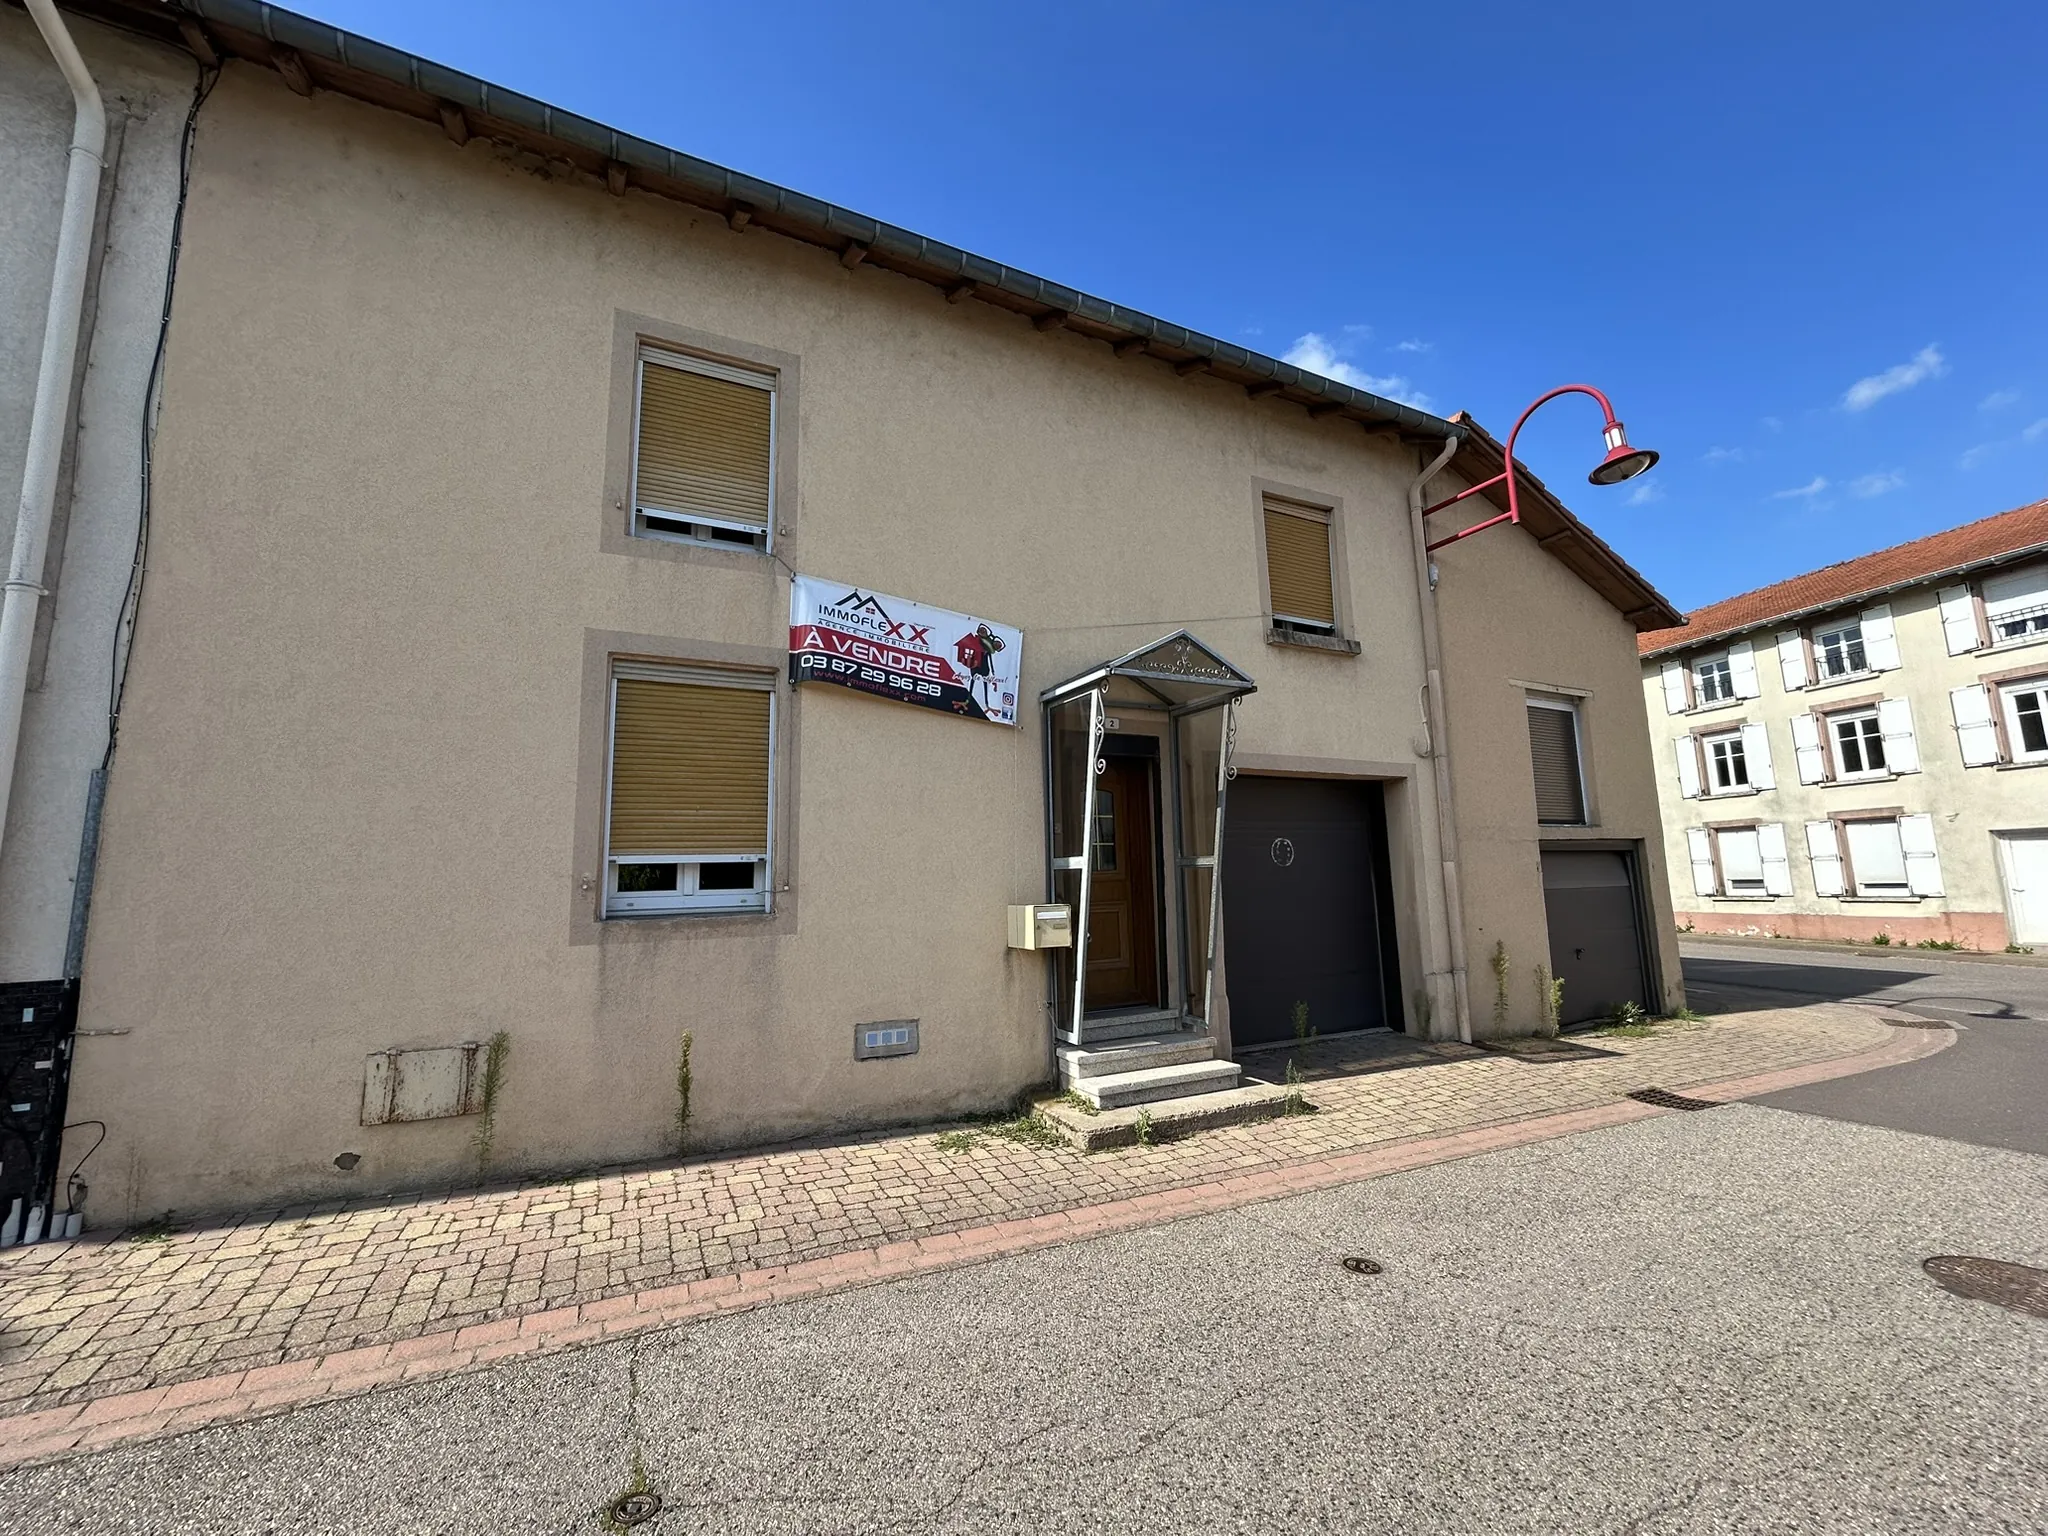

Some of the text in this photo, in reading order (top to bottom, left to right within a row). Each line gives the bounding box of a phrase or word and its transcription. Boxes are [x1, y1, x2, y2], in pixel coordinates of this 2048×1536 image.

[817, 620, 858, 635] AGENCE
[818, 604, 930, 646] IMMOFLEXX
[803, 626, 941, 678] À VENDRE
[801, 654, 942, 697] 03 87 29 96 28
[1109, 720, 1115, 728] 2
